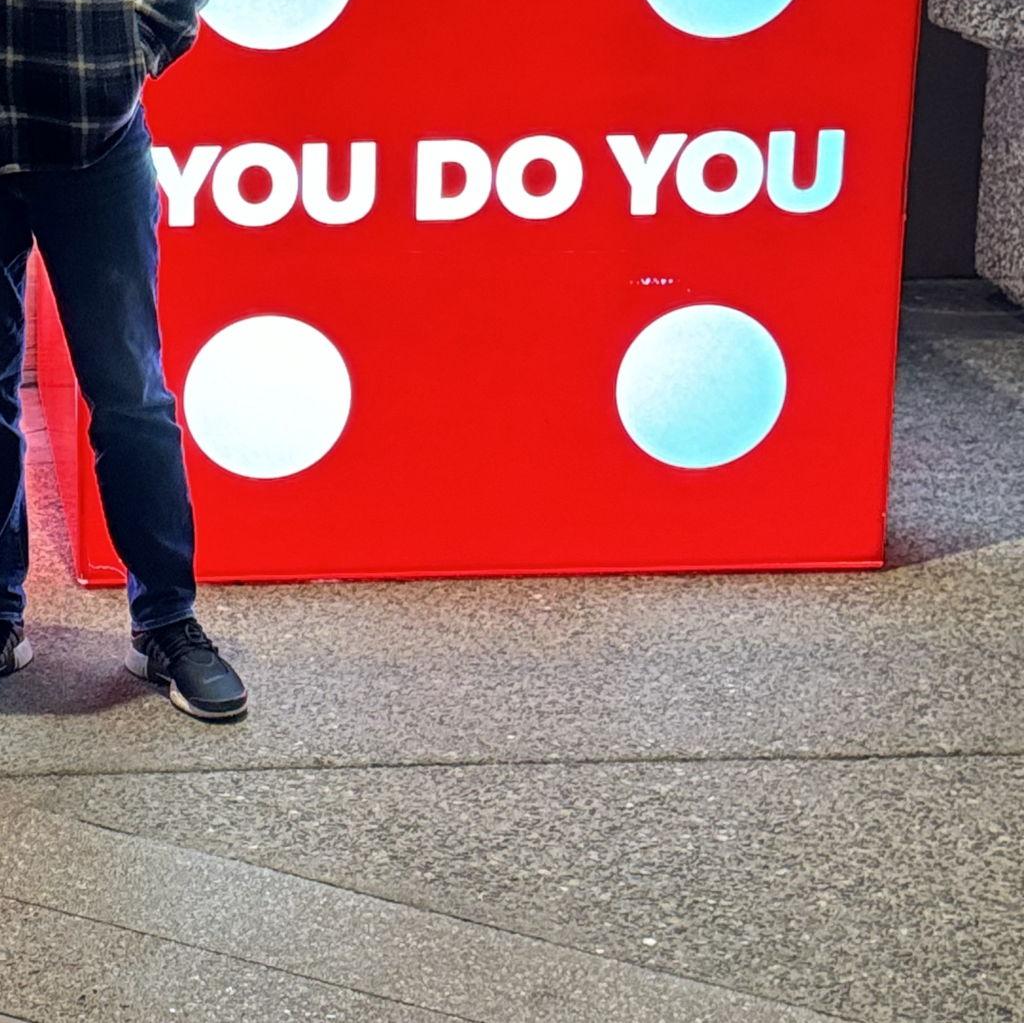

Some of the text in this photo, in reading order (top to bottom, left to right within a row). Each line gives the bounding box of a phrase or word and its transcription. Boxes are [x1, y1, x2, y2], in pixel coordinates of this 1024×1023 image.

[150, 129, 846, 227] YOU DO YOU
